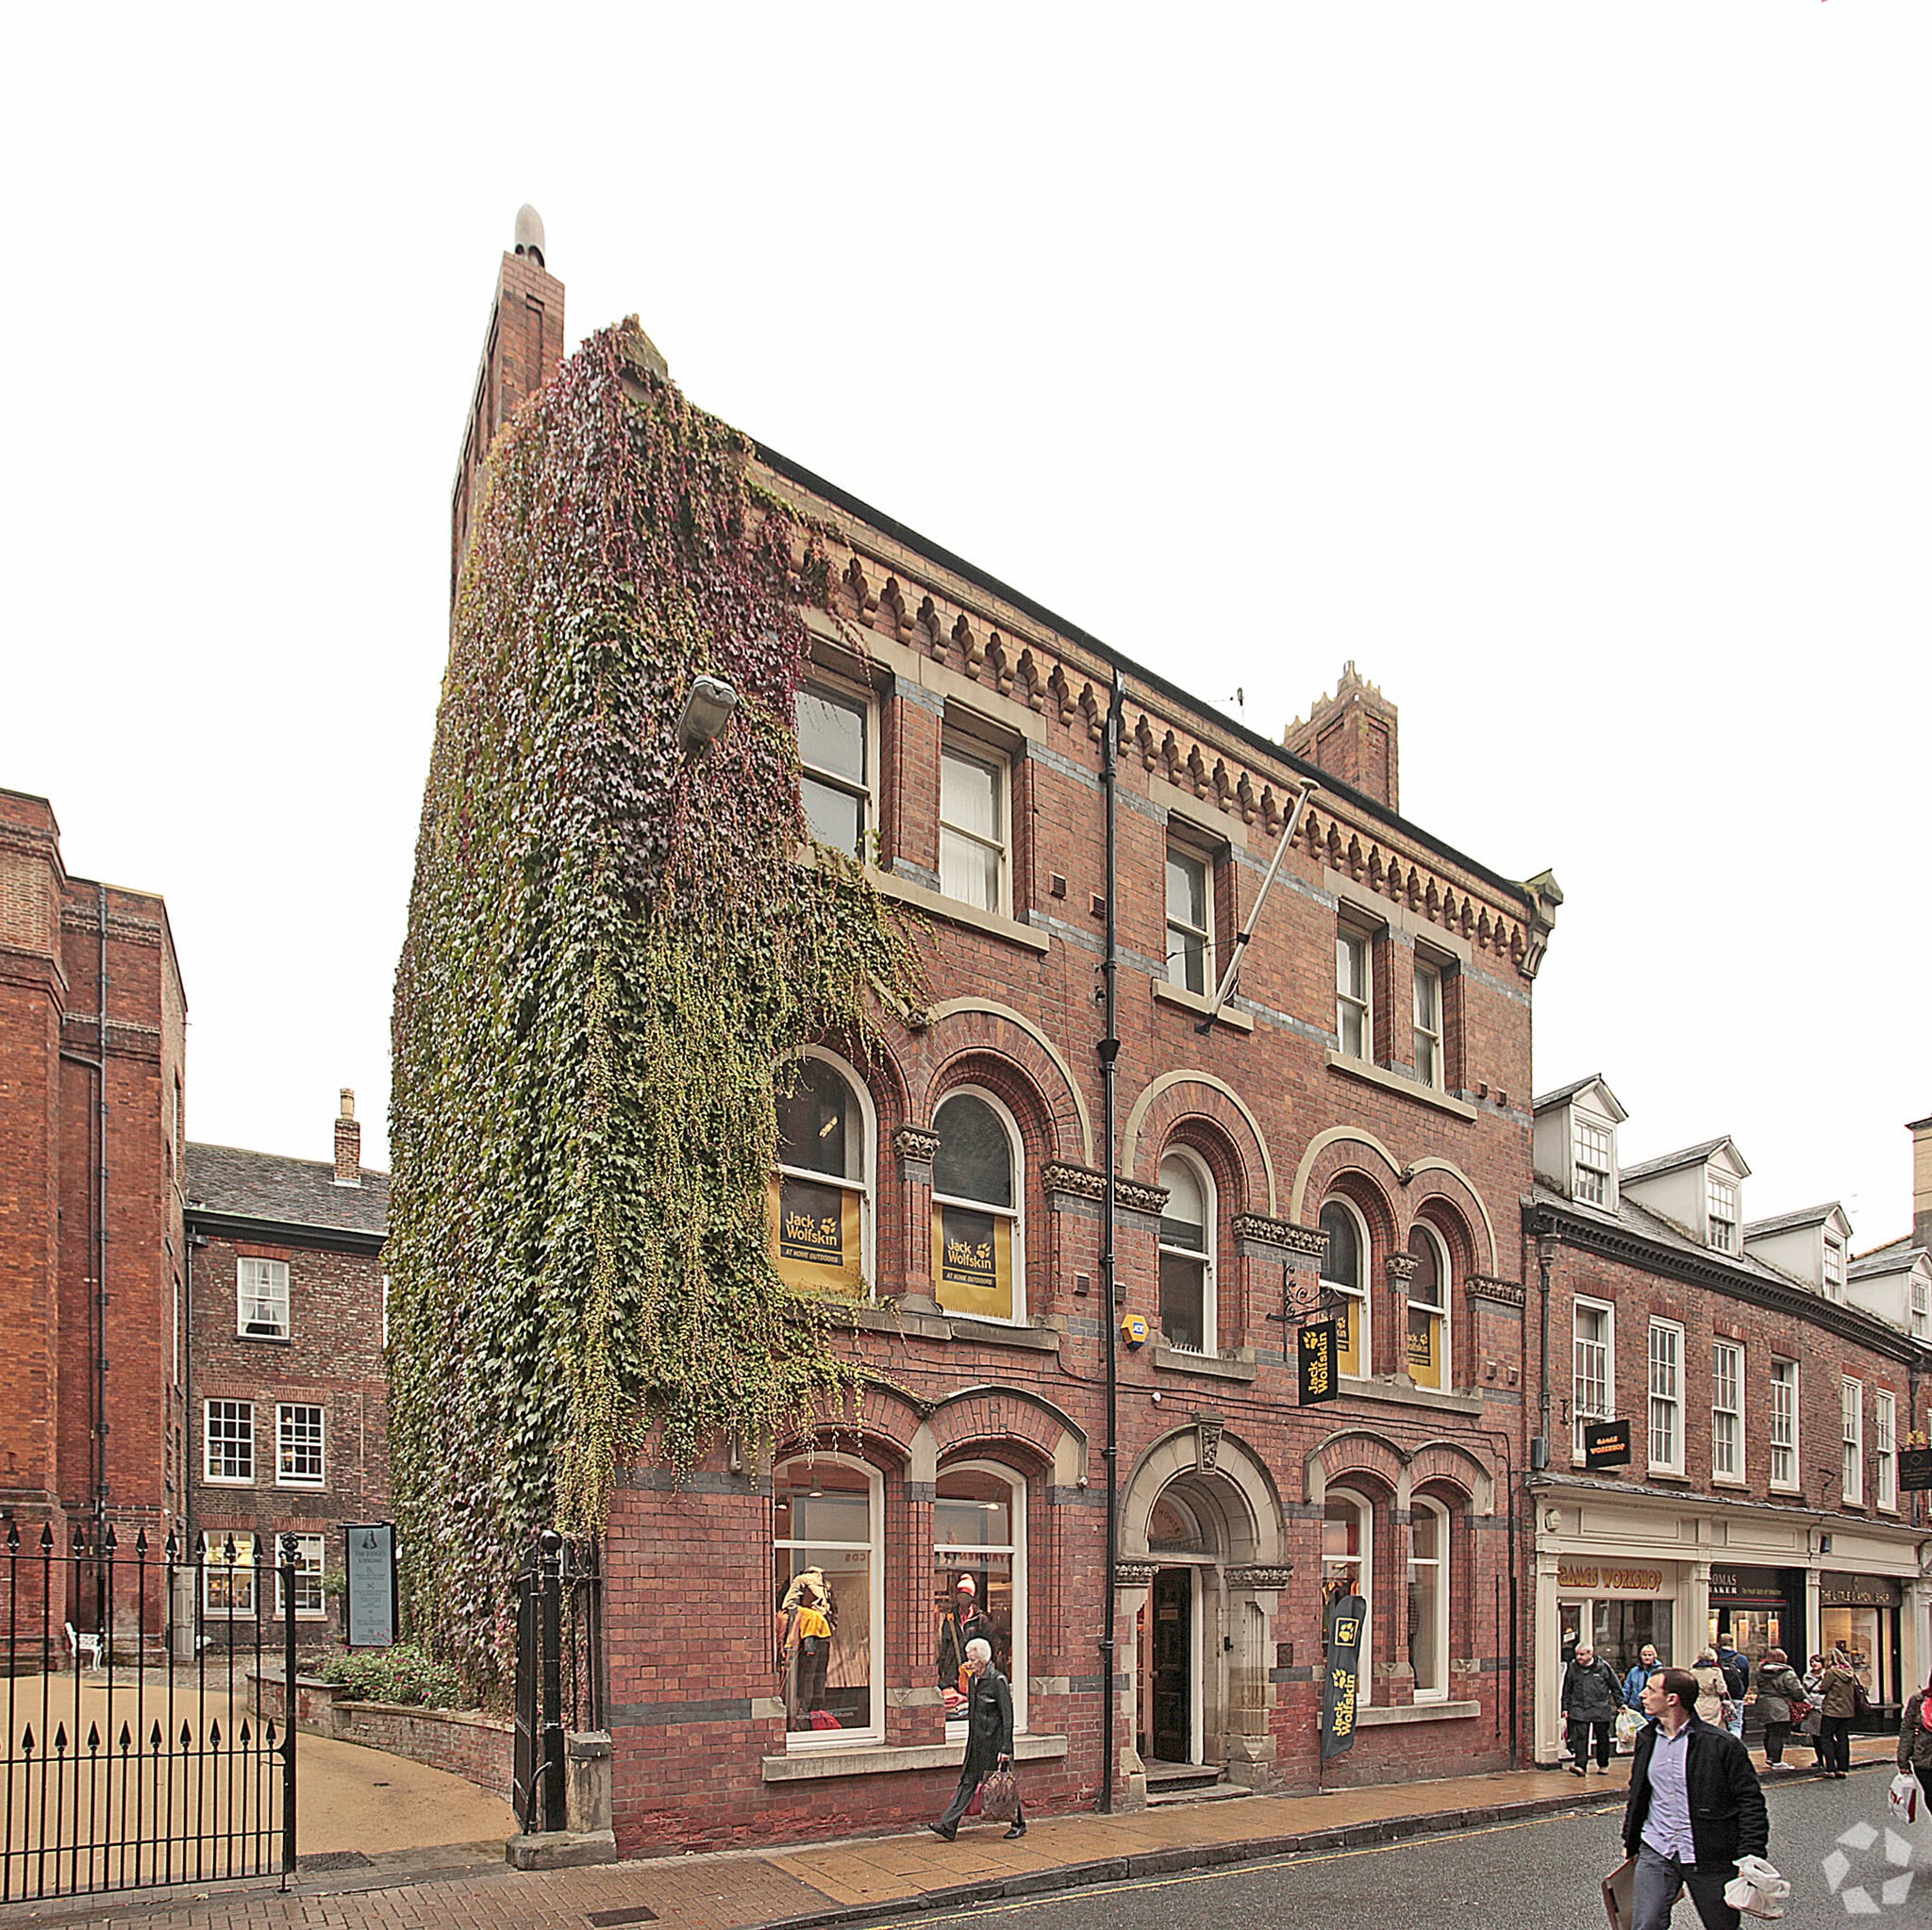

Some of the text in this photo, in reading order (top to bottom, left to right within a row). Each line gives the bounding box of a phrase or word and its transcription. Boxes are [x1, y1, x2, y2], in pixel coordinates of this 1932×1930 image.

[785, 1211, 815, 1229] Jack
[785, 1224, 838, 1246] Wolfskin
[947, 1239, 972, 1255] Jack
[808, 1253, 839, 1263] OUTDOORS
[947, 1250, 992, 1270] Wolfskin
[967, 1275, 992, 1285] OUTDOORS
[1317, 1332, 1328, 1394] Wolfskin
[1307, 1360, 1318, 1395] Jack
[1590, 1442, 1626, 1455] WORKSHOP
[1596, 1435, 1620, 1445] GAMES
[1158, 1506, 1181, 1535] HOUSE
[1557, 1564, 1662, 1592] GAMES WORKSHOP
[1710, 1572, 1738, 1586] OMAS
[1341, 1674, 1356, 1737] Wolfskin
[1332, 1701, 1344, 1737] Jack
